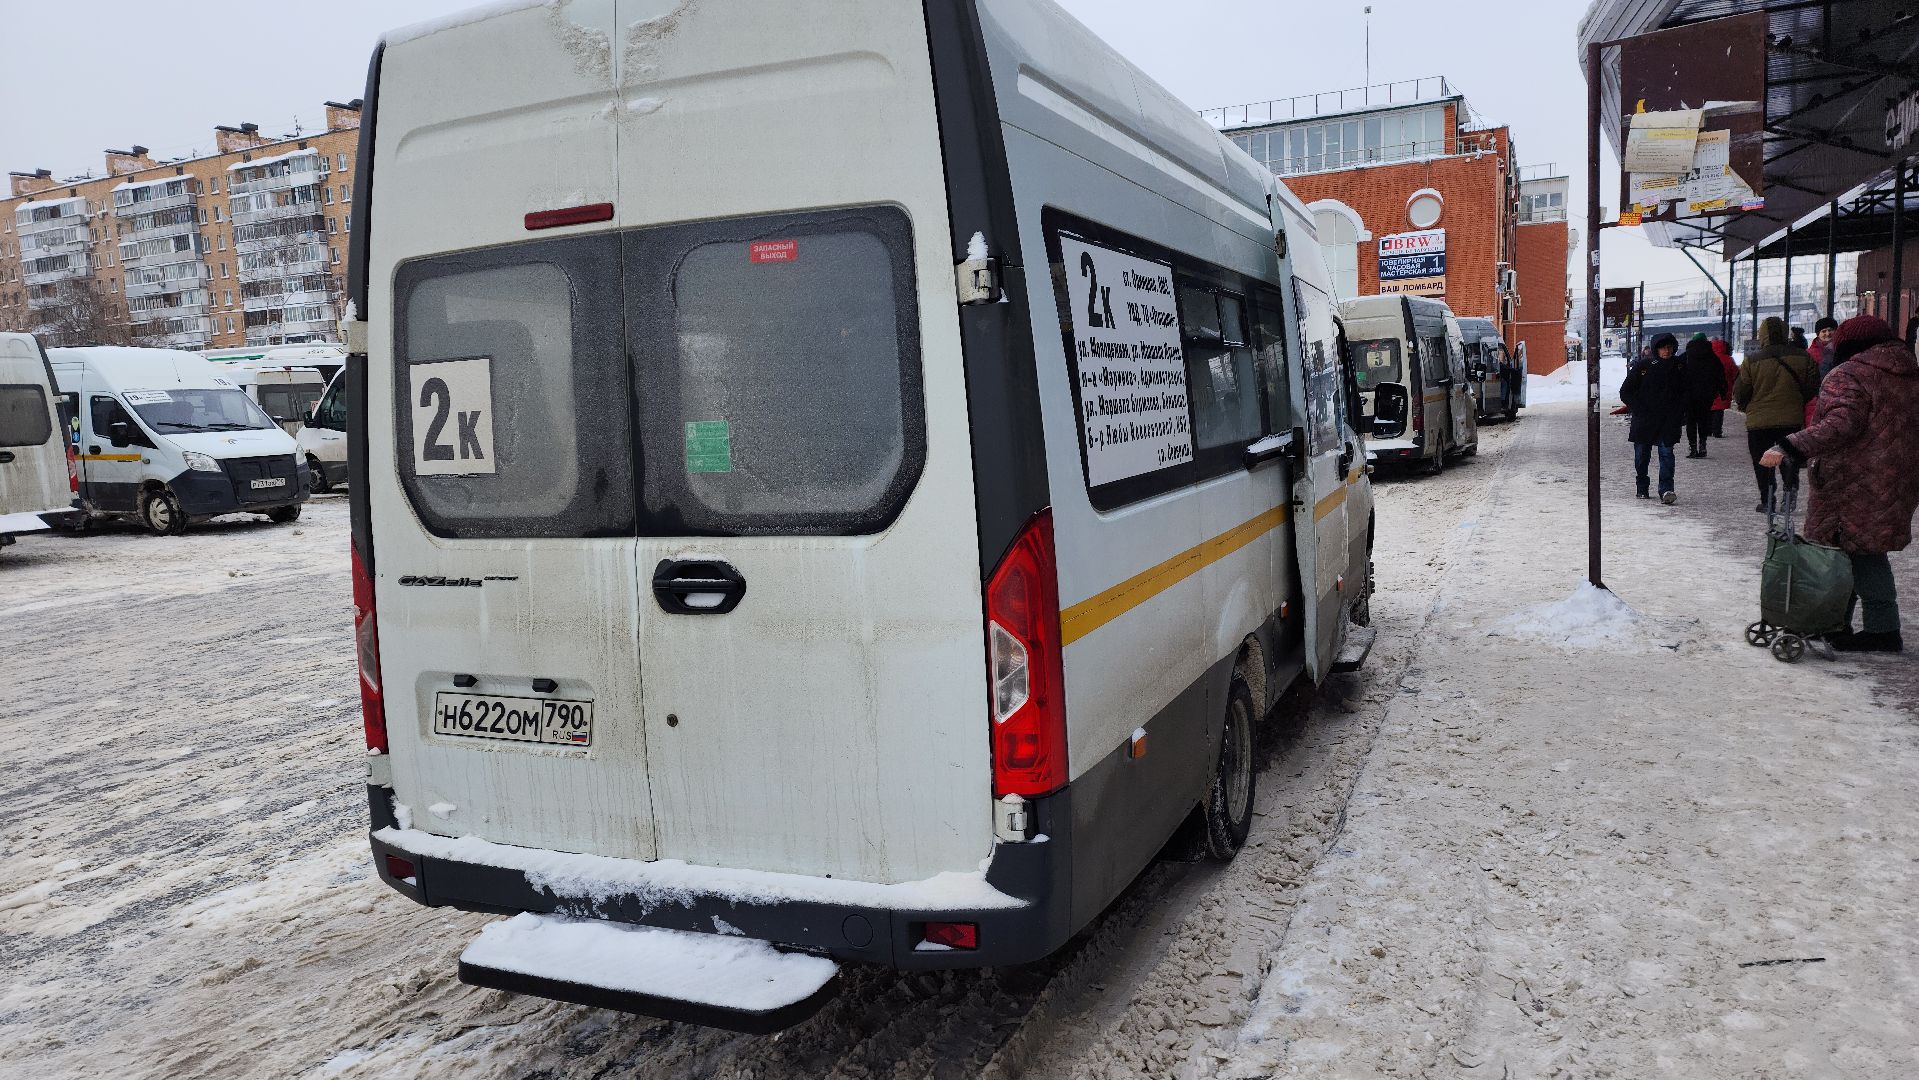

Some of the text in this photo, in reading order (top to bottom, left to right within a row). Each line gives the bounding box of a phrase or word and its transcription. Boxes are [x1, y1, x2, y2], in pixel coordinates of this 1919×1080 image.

[753, 241, 794, 252] ЗАПАСНЫЙ
[1394, 236, 1432, 250] BRW
[760, 251, 787, 260] ВЫХОД
[1381, 257, 1426, 266] ЮВЕЛИРНАЯ
[1387, 262, 1421, 271] ЧАСОВАЯ
[1432, 256, 1439, 267] 1
[1380, 268, 1427, 278] МАСТЕРСКАЯ
[1381, 281, 1444, 293] ВАШ ЛОМБАРД
[1085, 398, 1097, 419] ул.
[544, 702, 584, 730] 790
[552, 728, 572, 741] RUS
